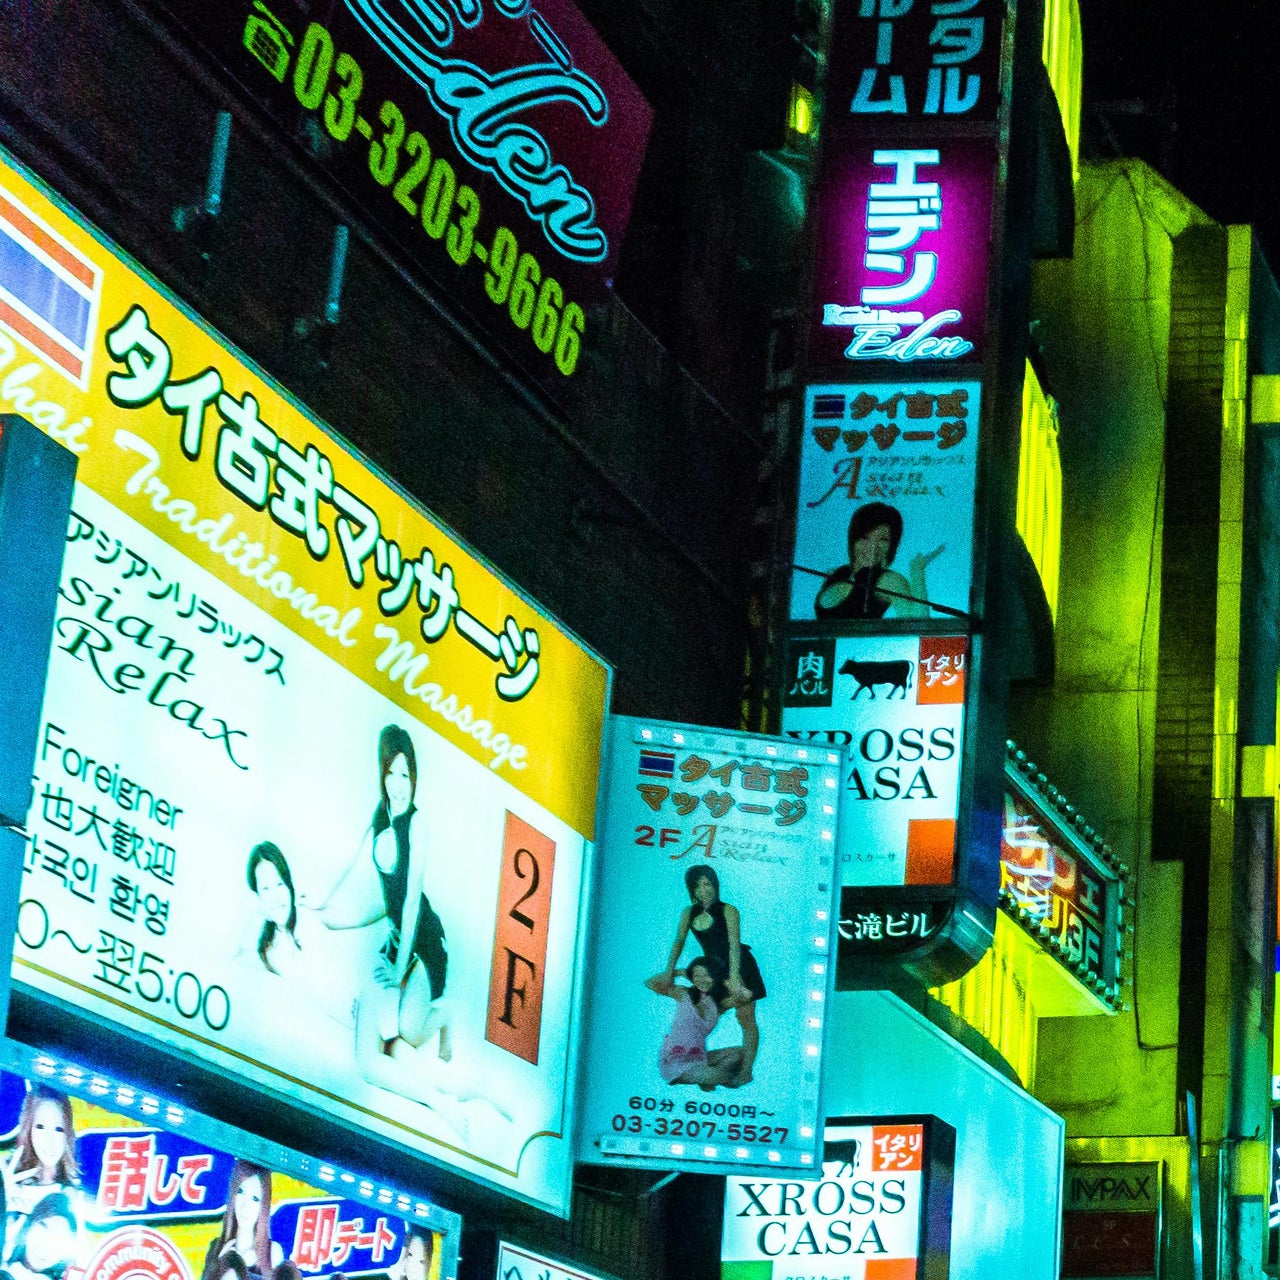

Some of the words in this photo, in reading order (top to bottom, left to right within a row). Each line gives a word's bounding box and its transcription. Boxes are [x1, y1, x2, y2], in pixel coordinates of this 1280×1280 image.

[294, 22, 586, 376] 03-3203-9666
[861, 149, 941, 307] エデン
[844, 309, 974, 361] Eden
[850, 389, 968, 420] タイ古式
[813, 420, 967, 452] マッサージ
[105, 304, 540, 702] タイ古式マッサージ
[65, 514, 287, 685] アジアンリラックス
[114, 429, 363, 646] Traditional
[374, 624, 529, 770] Massage
[797, 652, 824, 679] 肉
[920, 654, 966, 672] イタリ
[925, 671, 959, 687] アン
[56, 617, 249, 770] Relax
[790, 682, 828, 696] バル
[41, 722, 185, 831] Foreigner
[679, 754, 808, 797] タイ古式
[636, 783, 807, 826] マッサージ
[634, 825, 682, 848] 2F
[500, 847, 543, 1031] 2F
[628, 1095, 676, 1114] 60分
[611, 1114, 789, 1143] 03-3207-5527
[874, 1133, 922, 1153] イタリ
[99, 1135, 213, 1212] 話して
[881, 1151, 914, 1170] アン
[735, 1179, 906, 1218] XROSS
[290, 1204, 397, 1273] 即デート
[758, 1221, 888, 1256] CASA
